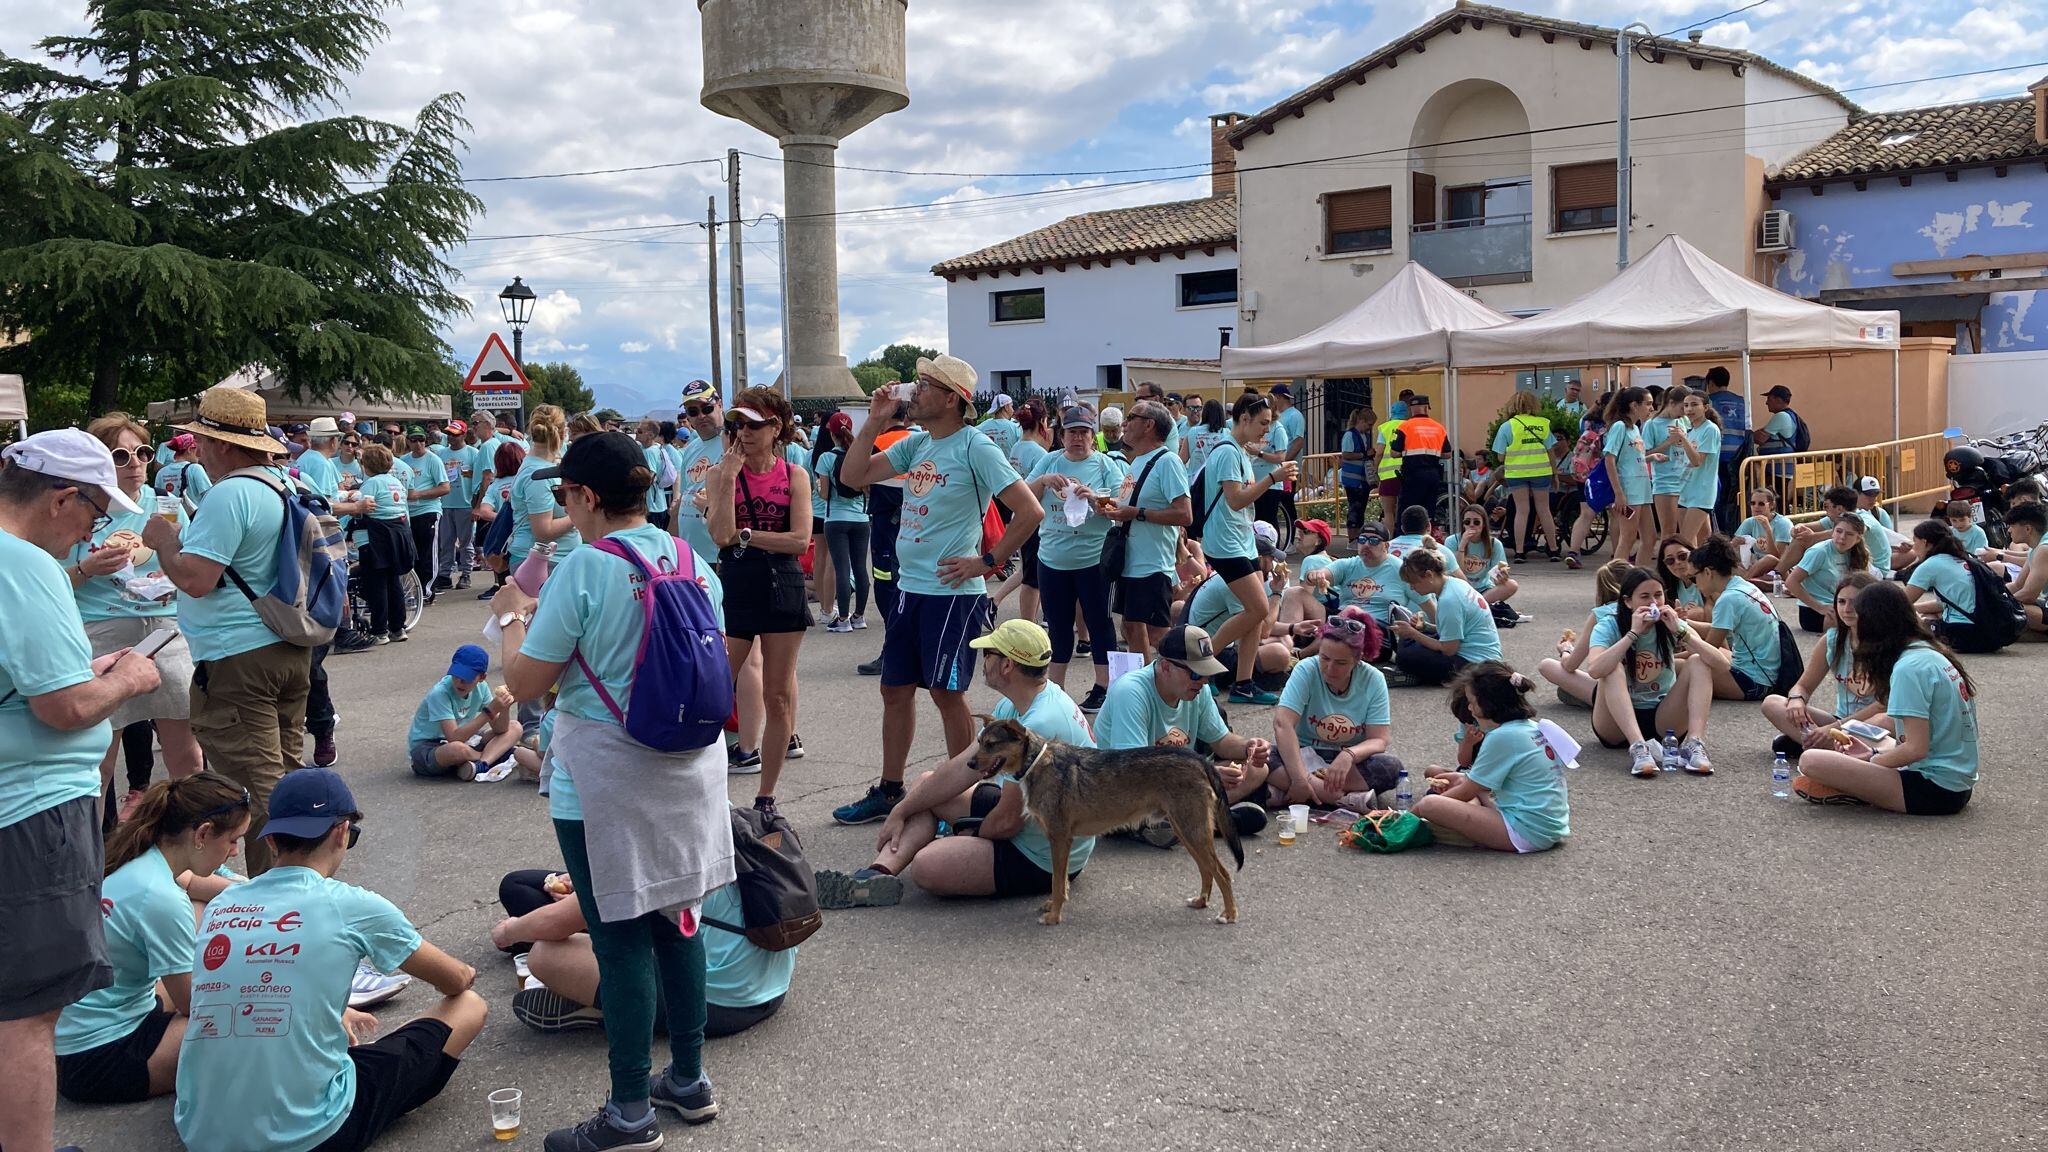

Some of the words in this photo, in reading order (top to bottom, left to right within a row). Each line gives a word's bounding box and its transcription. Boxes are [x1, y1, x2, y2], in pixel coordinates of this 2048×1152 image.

[211, 904, 265, 918] Fundación
[206, 916, 263, 934] iberCaja
[245, 942, 301, 956] KIA
[240, 984, 292, 994] escanero
